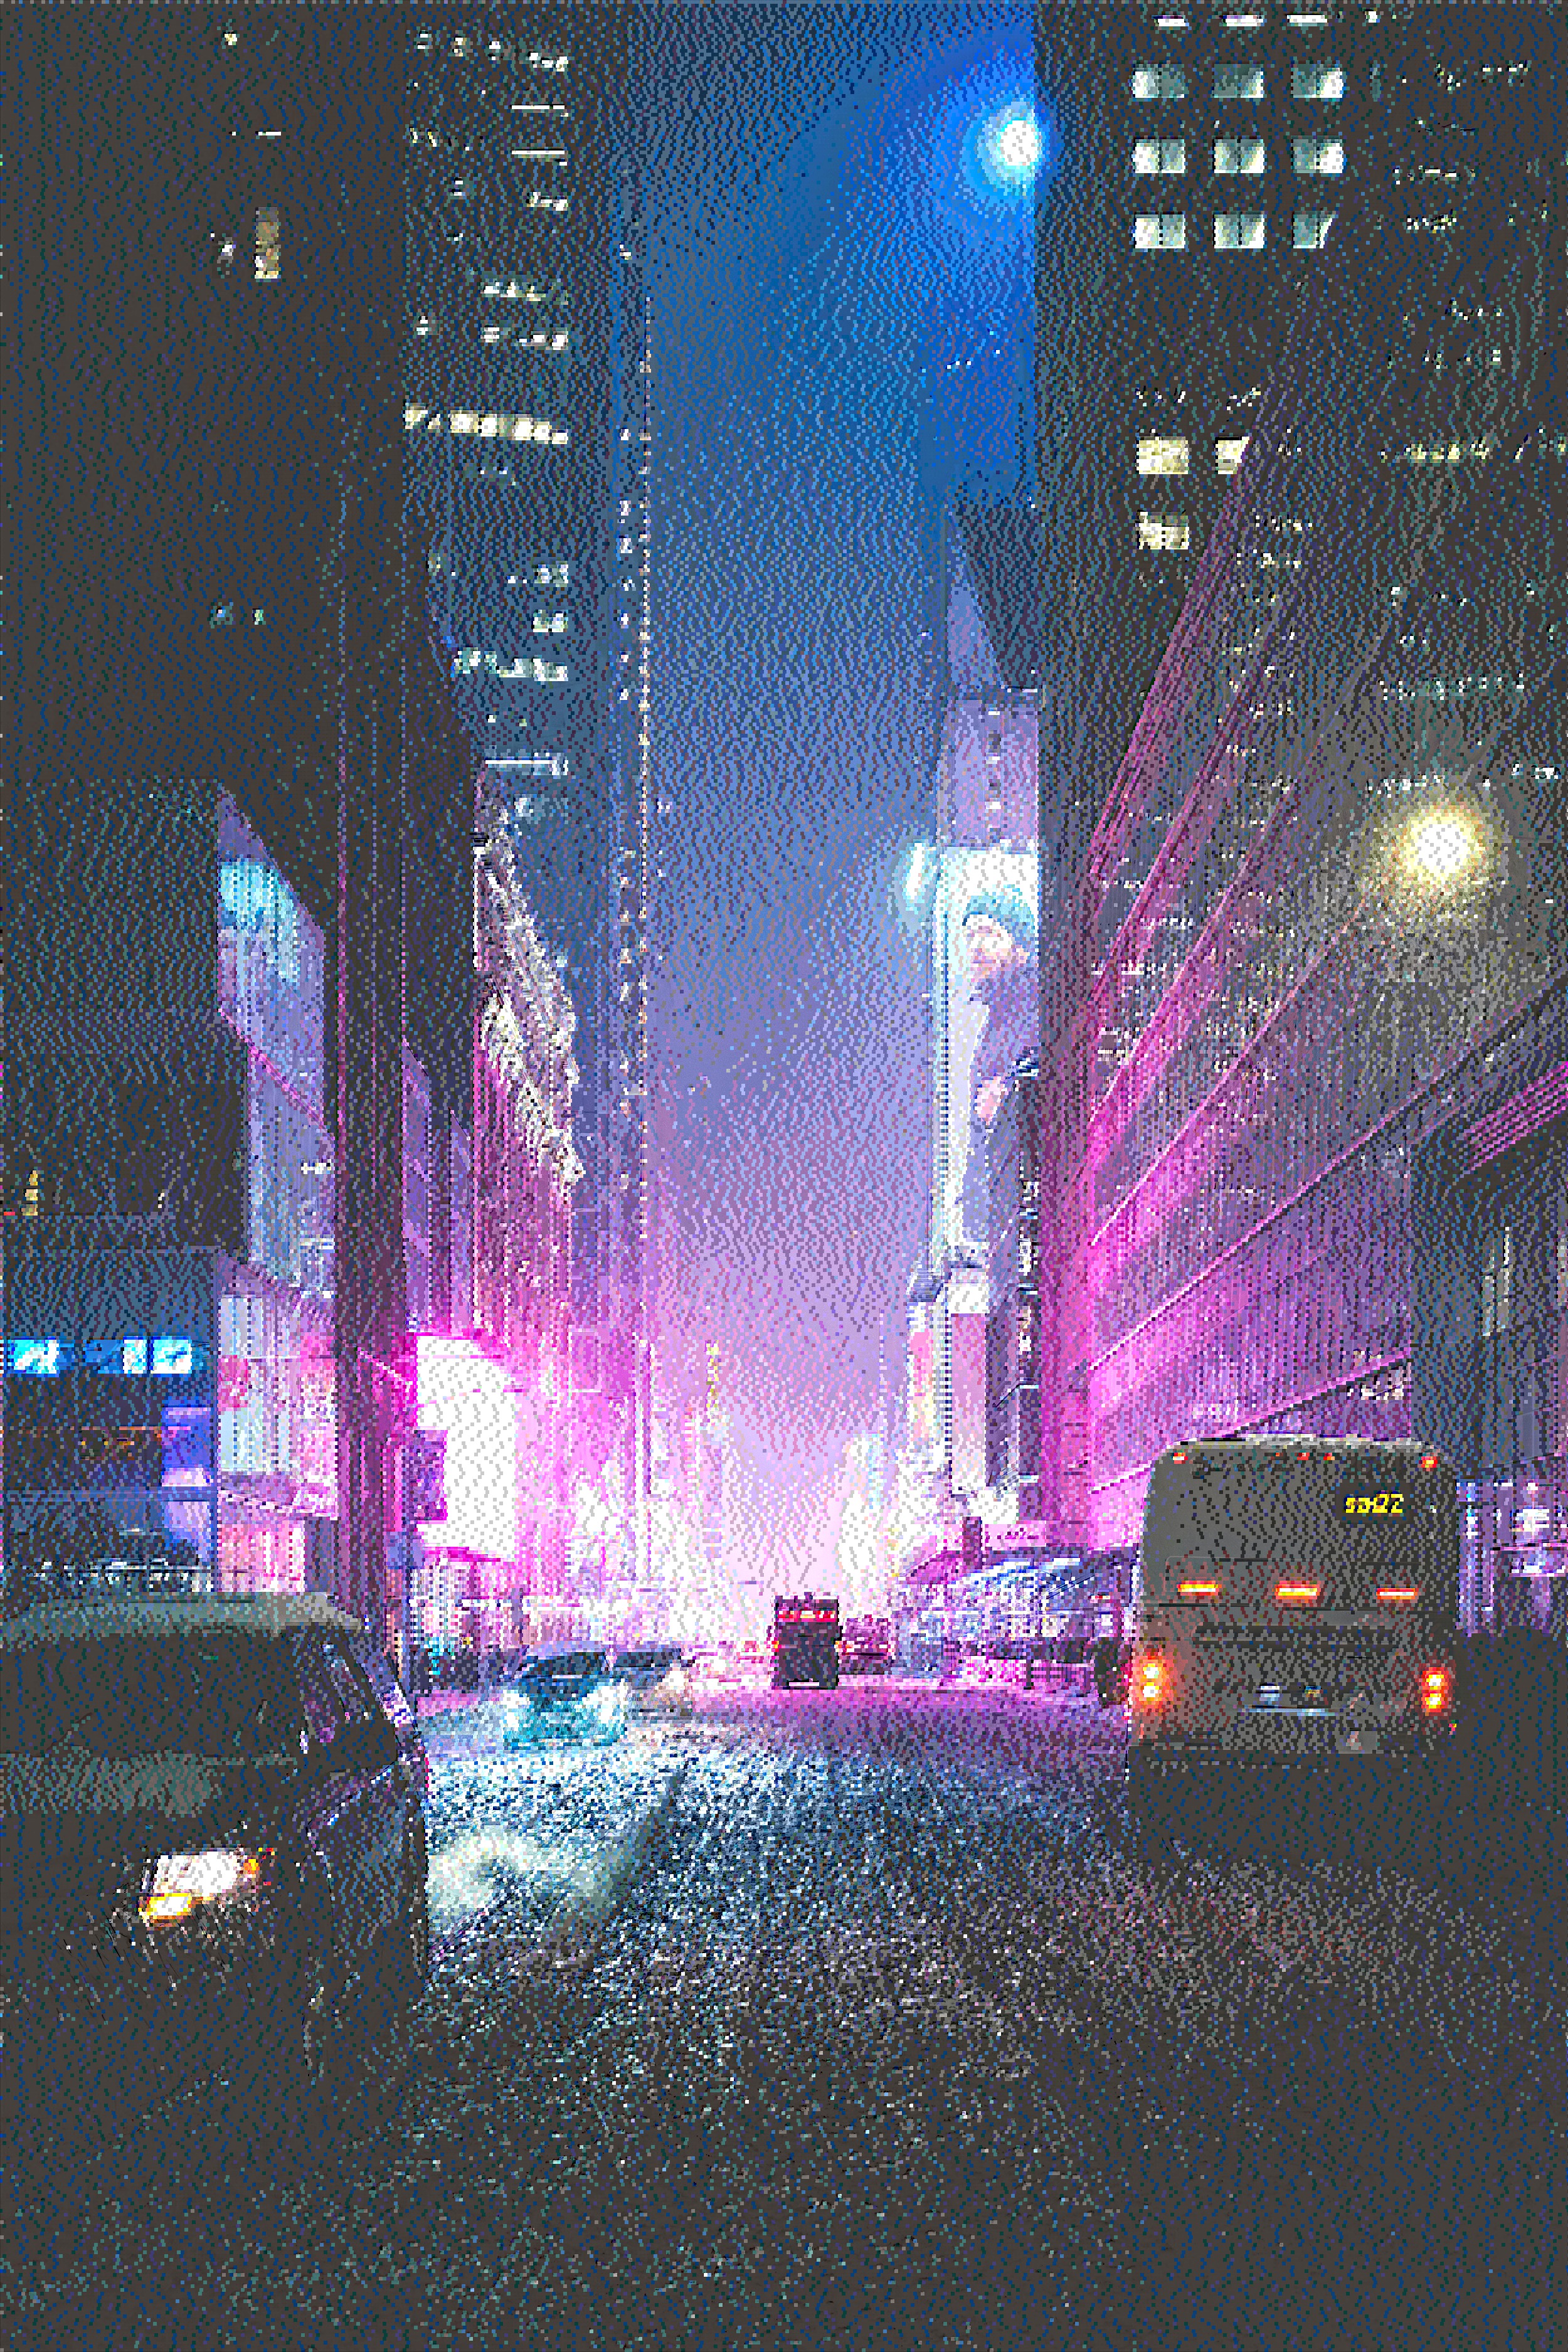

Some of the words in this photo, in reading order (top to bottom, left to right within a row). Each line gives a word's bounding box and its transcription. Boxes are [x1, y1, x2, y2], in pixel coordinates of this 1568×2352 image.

[1211, 1462, 1232, 1471] New
[1233, 1462, 1253, 1471] York
[1255, 1463, 1274, 1473] City
[1276, 1463, 1295, 1471] Bus
